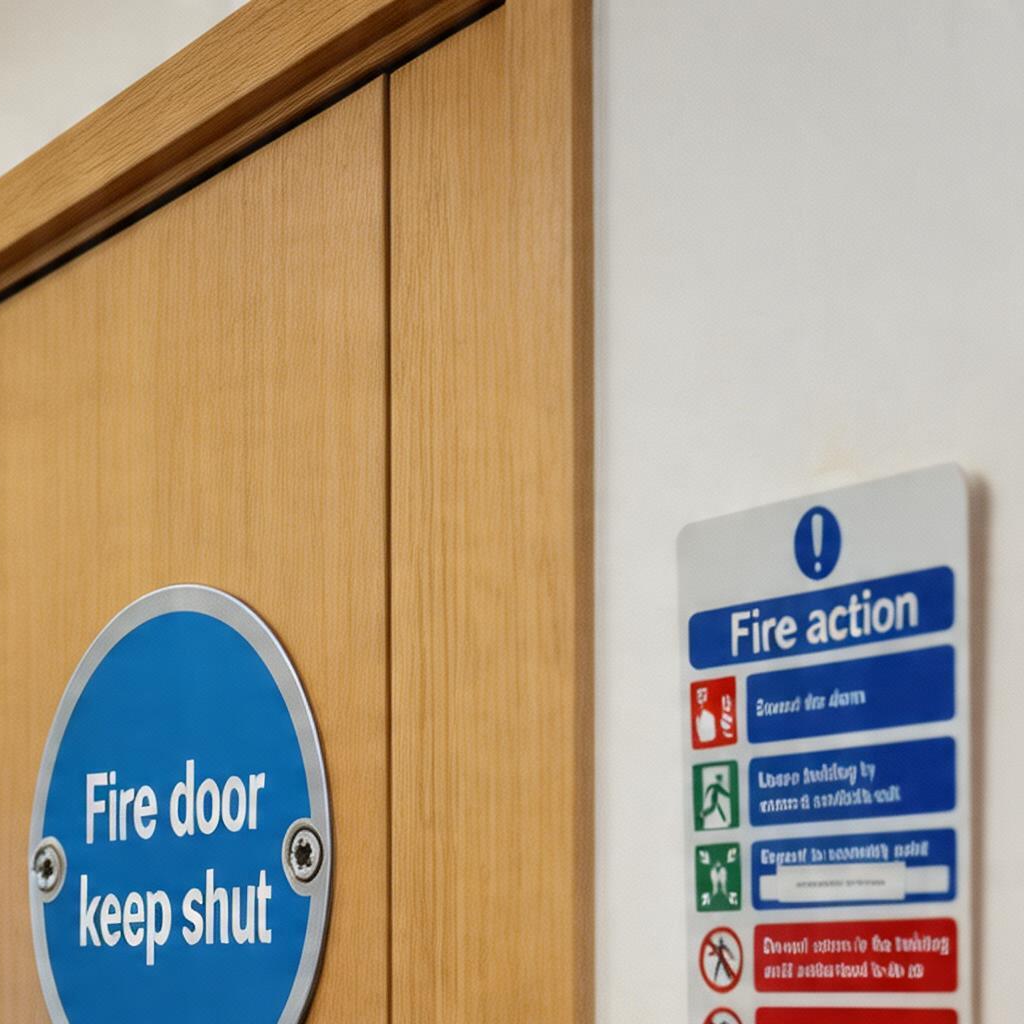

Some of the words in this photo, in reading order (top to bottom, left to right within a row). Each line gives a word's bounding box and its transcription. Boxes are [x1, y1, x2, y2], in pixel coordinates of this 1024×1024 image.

[730, 608, 798, 657] Fire
[805, 588, 919, 645] action
[85, 770, 158, 845] Fire
[169, 758, 266, 838] door
[79, 873, 173, 967] keep
[181, 868, 273, 946] shut
